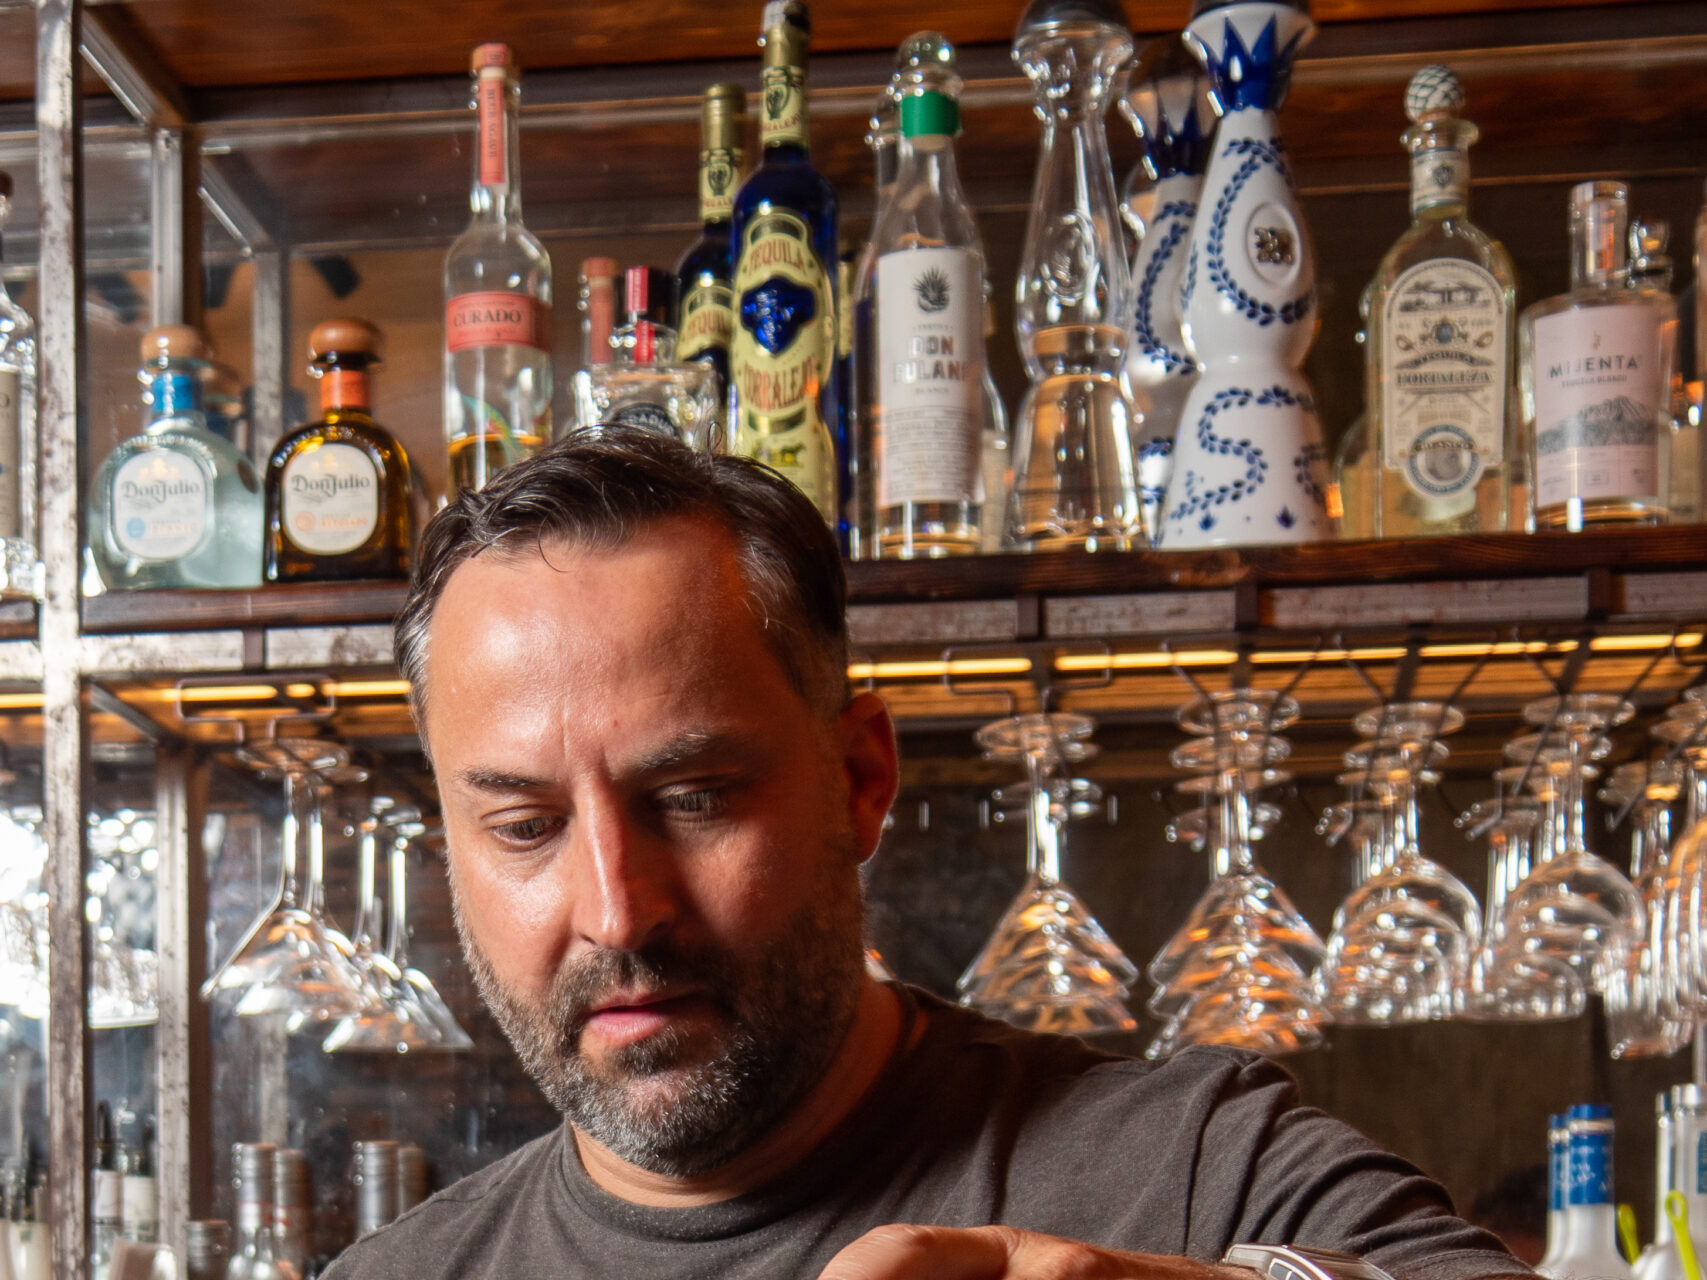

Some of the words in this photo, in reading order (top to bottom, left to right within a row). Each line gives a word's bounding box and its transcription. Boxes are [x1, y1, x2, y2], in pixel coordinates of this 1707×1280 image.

[749, 239, 807, 278] TEQUILA
[453, 308, 522, 328] CURADO
[911, 335, 954, 356] DON
[1548, 354, 1639, 379] MIJENTA
[1396, 370, 1496, 386] FORTALEZA
